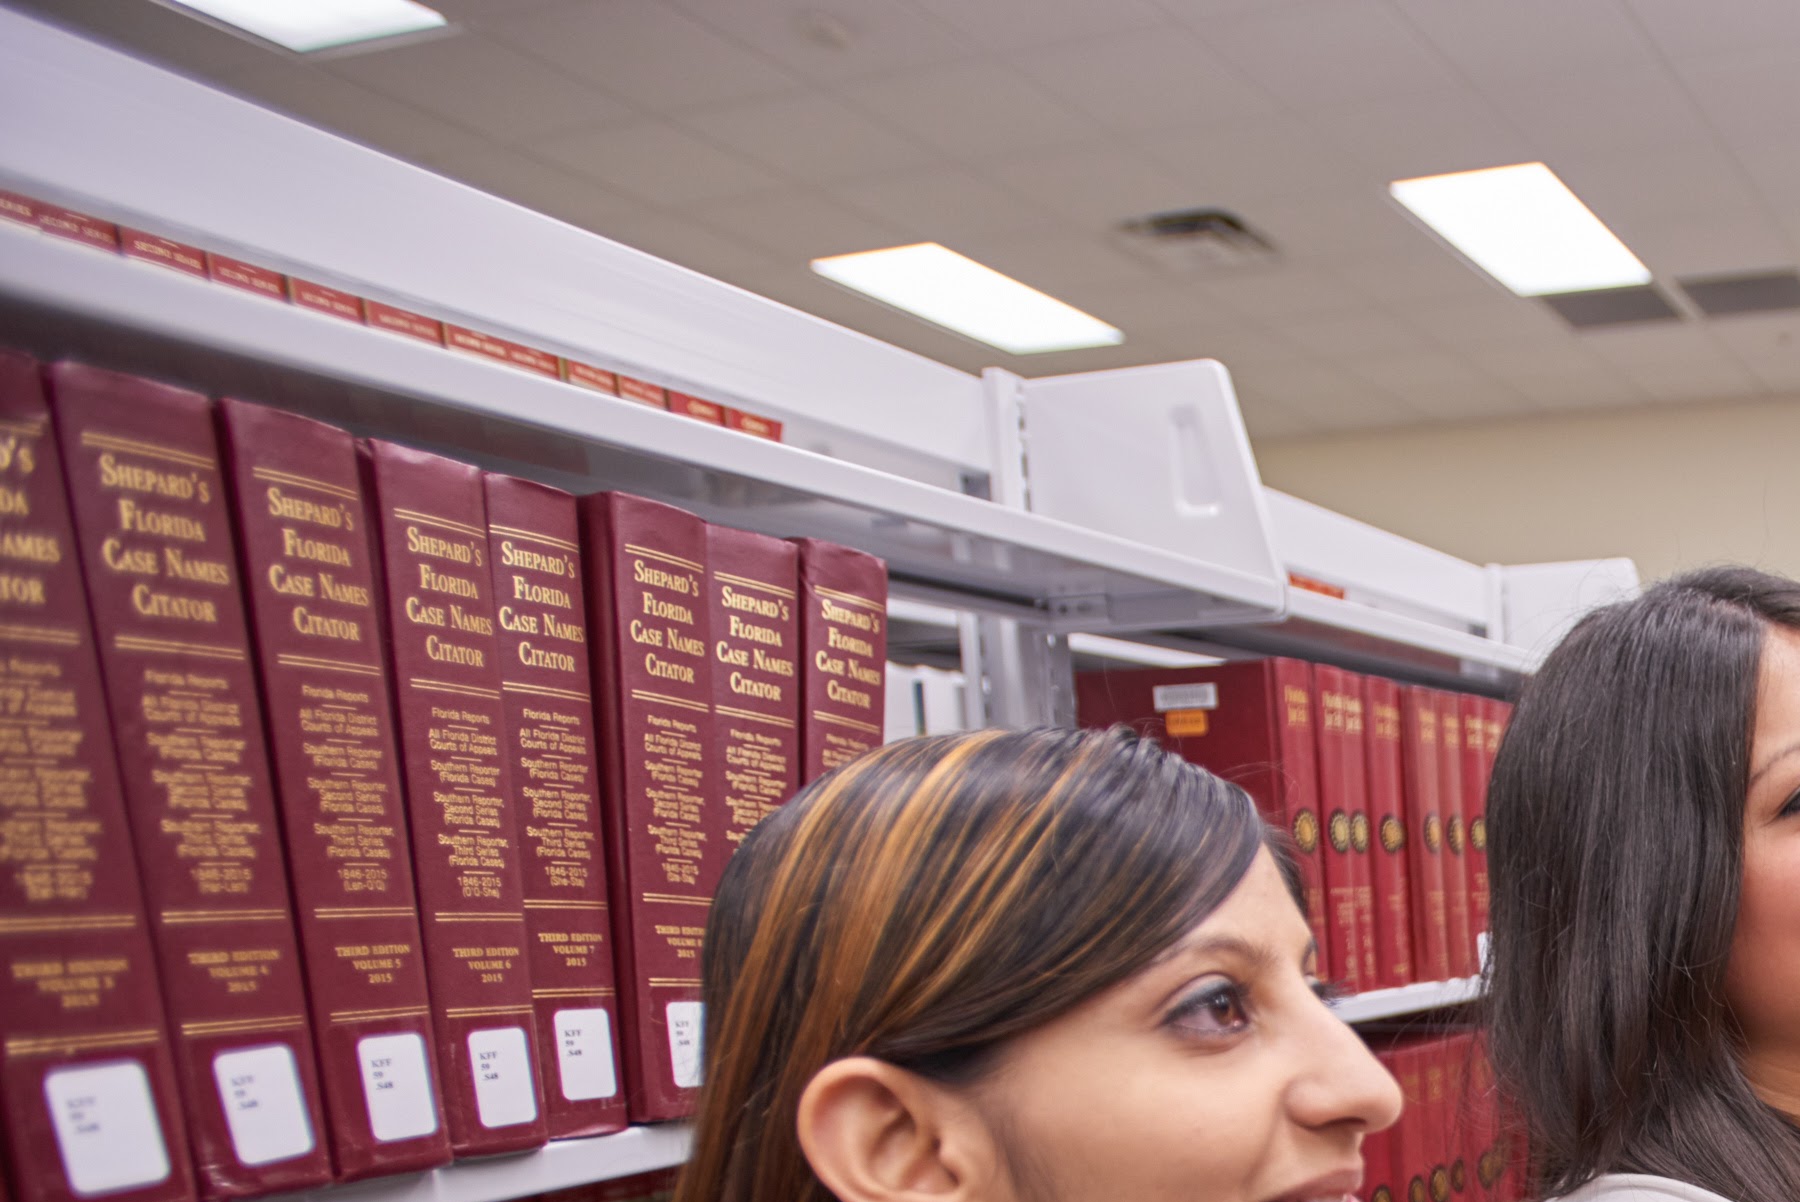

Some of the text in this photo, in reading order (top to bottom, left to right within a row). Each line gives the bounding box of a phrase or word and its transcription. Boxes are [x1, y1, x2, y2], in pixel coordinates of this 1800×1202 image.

[100, 452, 211, 503] SHEPARD'S
[119, 499, 206, 542] FLORIDA
[267, 487, 353, 531] SHEPARD'S
[0, 533, 62, 565] AMES
[282, 528, 352, 567] FLORIDA
[407, 527, 483, 567] SHEPARD'S
[102, 539, 230, 585] CASE NAMES
[501, 541, 575, 579] SHEPARD'S
[269, 564, 370, 607] CASE NAMES
[419, 564, 479, 599] FLORIDA
[634, 559, 699, 597] SHEPARD'S
[132, 585, 216, 622] CITATOR
[512, 576, 572, 609] FLORIDA
[721, 586, 790, 622] SHEPARD'S
[406, 597, 492, 636] CASE NAMES
[642, 591, 694, 625] FLORIDA
[821, 599, 880, 634] SHEPARD'S
[293, 607, 359, 642] CITATOR
[499, 606, 584, 643] CASE NAMES
[729, 616, 782, 647] FLORIDA
[630, 620, 705, 658] CASE NAMES
[827, 626, 874, 658] FLORIDA
[426, 635, 484, 668] CITATOR
[518, 641, 575, 673] CITATOR
[716, 641, 794, 678] CASE NAMES
[645, 653, 695, 684] CITATOR
[815, 650, 881, 686] CASE NAMES
[302, 684, 369, 703] Florida Reports
[730, 672, 781, 701] CITATOR
[827, 680, 871, 709] CITATOR
[432, 707, 490, 725] Florida Reports
[523, 708, 580, 725] Florida Reports
[429, 739, 457, 751] Courts
[459, 742, 467, 752] of
[442, 730, 469, 742] Florida
[471, 733, 496, 745] District
[520, 738, 547, 750] Courts
[550, 741, 557, 751] of
[533, 729, 559, 741] Florida
[561, 732, 586, 745] District
[430, 760, 500, 776] Southern Reporter
[520, 757, 588, 773] Southern Reporter
[433, 792, 470, 803] Southern
[522, 787, 559, 799] Southern
[532, 798, 586, 811] Second Series
[443, 803, 498, 817] Second Series
[438, 833, 475, 845] Southern
[526, 826, 563, 838] Southern
[542, 837, 586, 849] Third Series
[452, 844, 499, 857] Third Series
[538, 932, 603, 943] THIRD EDITION
[552, 944, 588, 955] VOLUME
[335, 944, 411, 958] THIRD EDITION
[452, 946, 520, 958] THIRD EDITION
[566, 956, 588, 967] 2015
[353, 959, 394, 971] VOLUME
[468, 959, 502, 971] VOLUME
[368, 972, 392, 984] 2015
[481, 972, 503, 984] 2015
[564, 1028, 582, 1038] KFF
[371, 1058, 392, 1069] KFF
[479, 1051, 498, 1061] KFF
